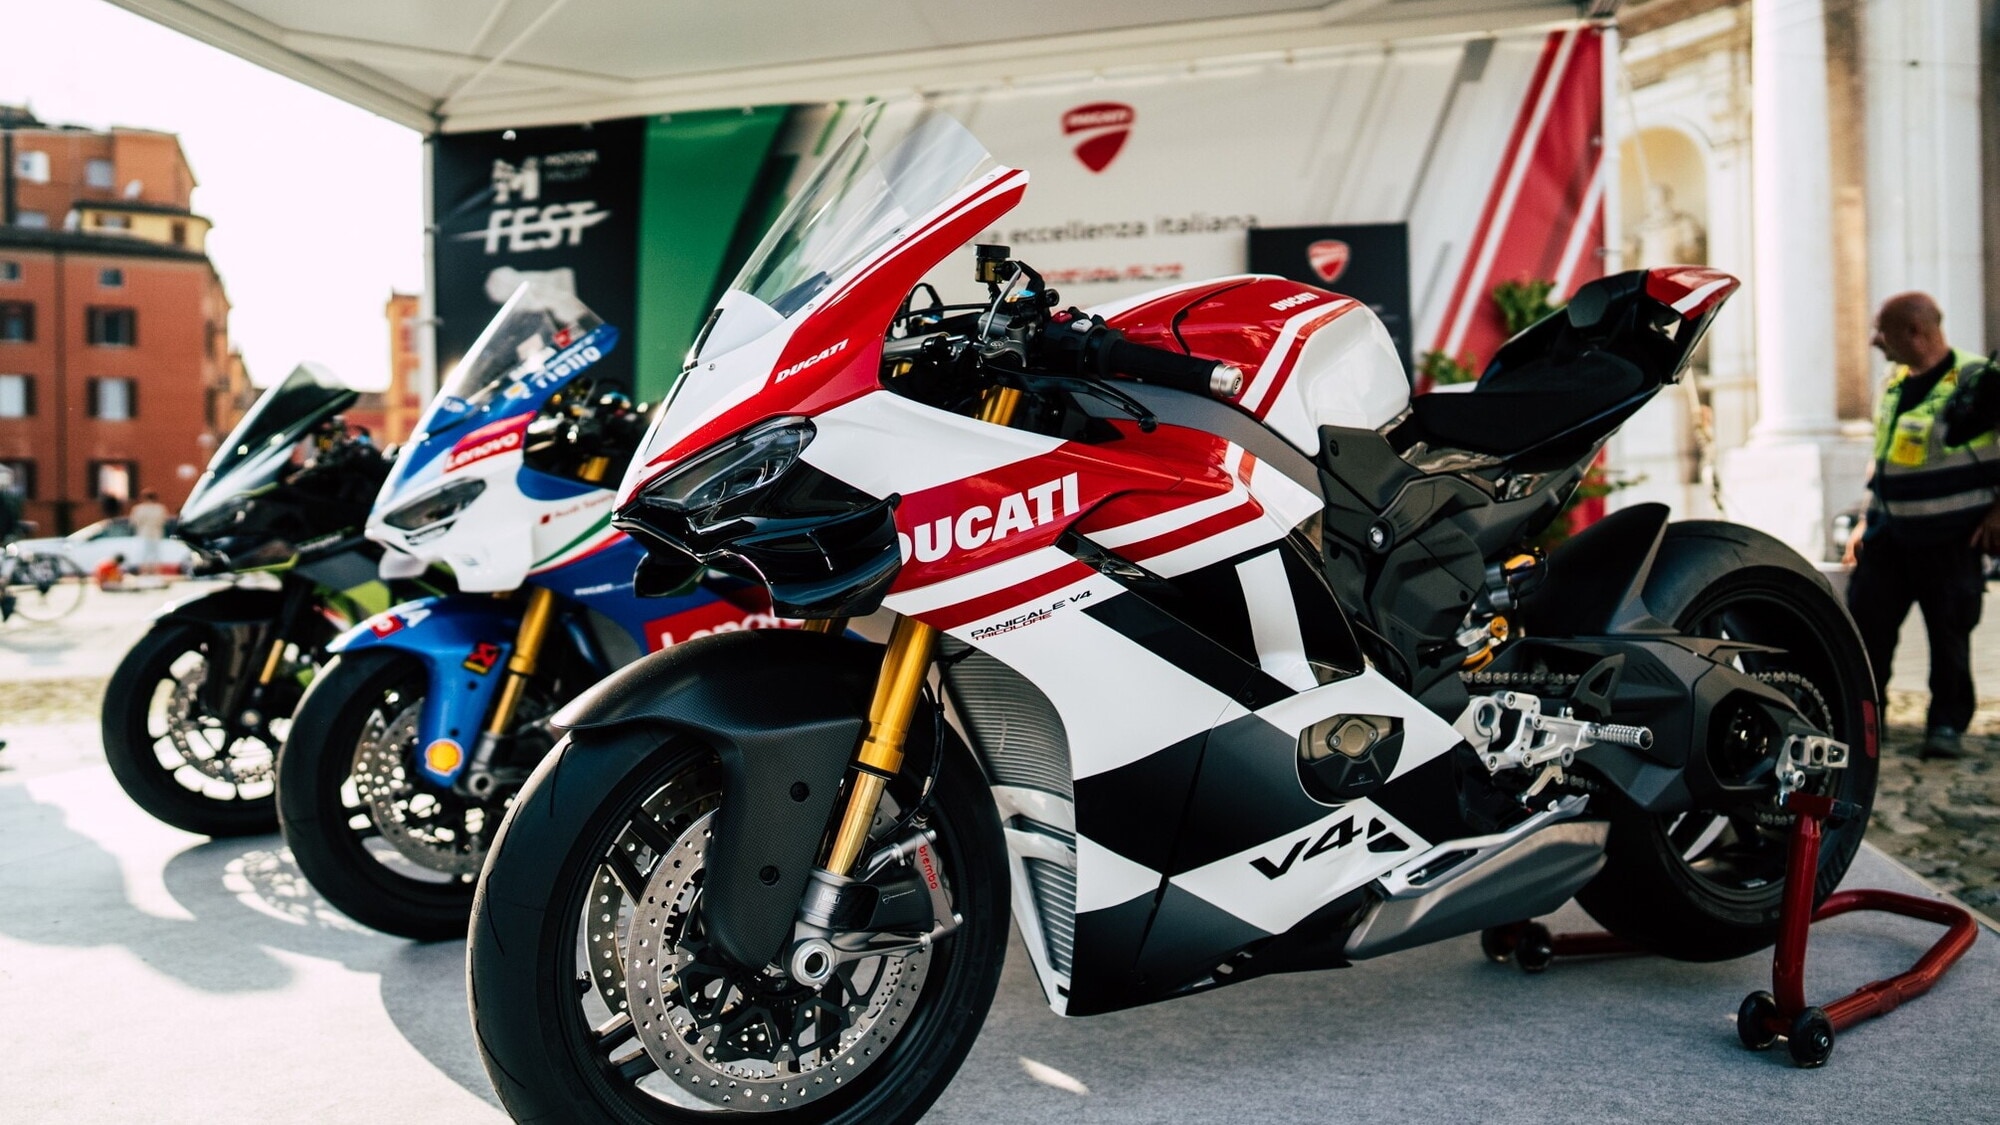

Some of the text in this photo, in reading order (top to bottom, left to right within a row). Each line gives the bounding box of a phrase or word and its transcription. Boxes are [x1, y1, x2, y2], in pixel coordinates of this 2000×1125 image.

[484, 200, 598, 255] FEST
[1154, 212, 1259, 236] italiana
[1269, 292, 1320, 311] DUCATI
[774, 338, 850, 385] DUCATI
[446, 432, 520, 470] Lenovo
[970, 590, 1092, 638] PANIGALE V4
[973, 612, 1053, 641] TRICOLORE
[919, 844, 938, 890] brembo
[1249, 815, 1363, 880] V4
